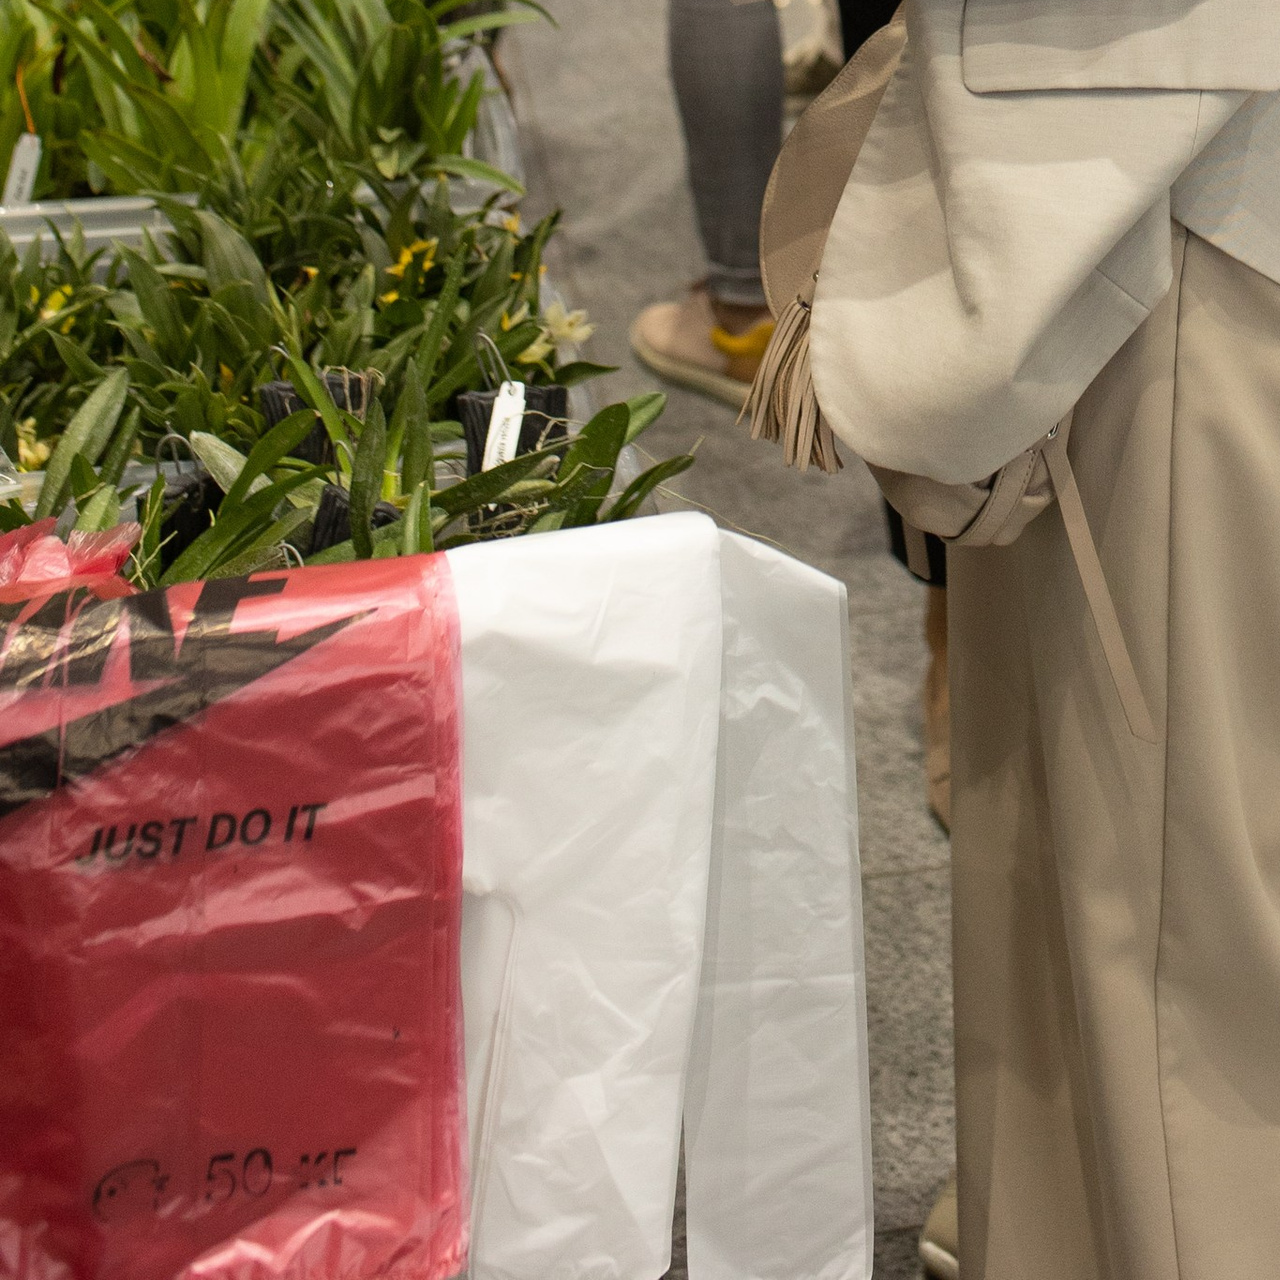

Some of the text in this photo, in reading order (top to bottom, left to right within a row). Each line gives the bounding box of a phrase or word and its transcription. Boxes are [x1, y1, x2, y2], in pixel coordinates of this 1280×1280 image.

[74, 803, 328, 867] JUST DO IT
[206, 1148, 273, 1202] 50
